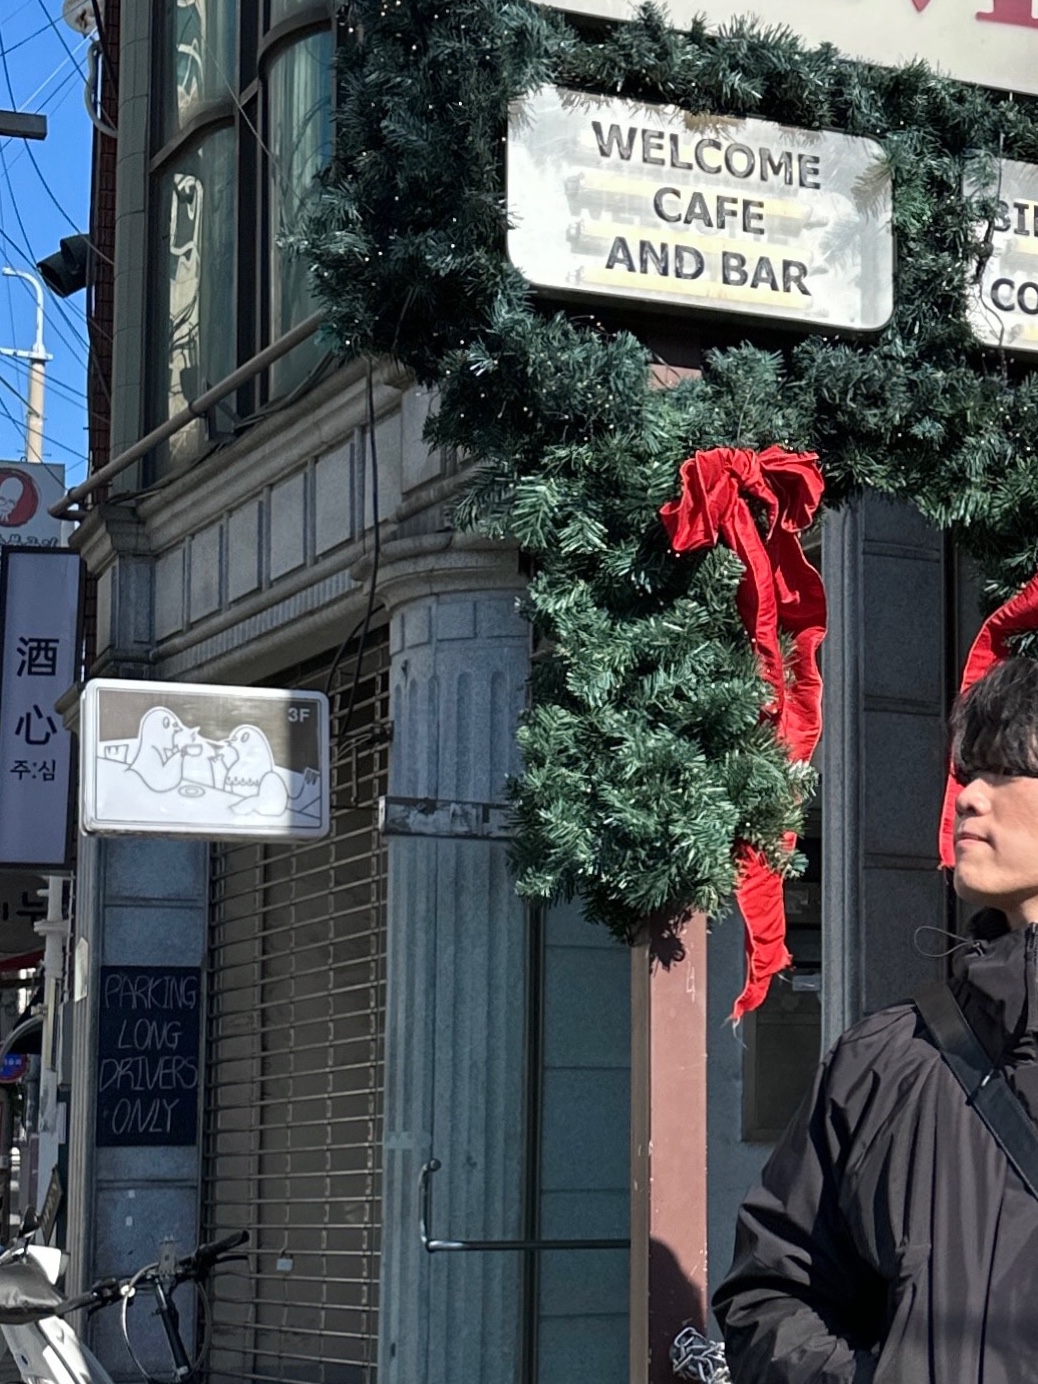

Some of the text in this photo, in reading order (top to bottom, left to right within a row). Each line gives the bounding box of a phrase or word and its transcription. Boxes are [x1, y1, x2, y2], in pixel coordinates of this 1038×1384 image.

[591, 120, 822, 190] WELCOME
[653, 186, 765, 235] CAFE
[605, 236, 812, 296] AND BAR
[288, 707, 311, 722] 3F
[105, 974, 198, 1009] PARKING
[118, 1018, 183, 1050] LONG
[99, 1055, 198, 1092] DRIVERS
[112, 1098, 179, 1134] ONLY
